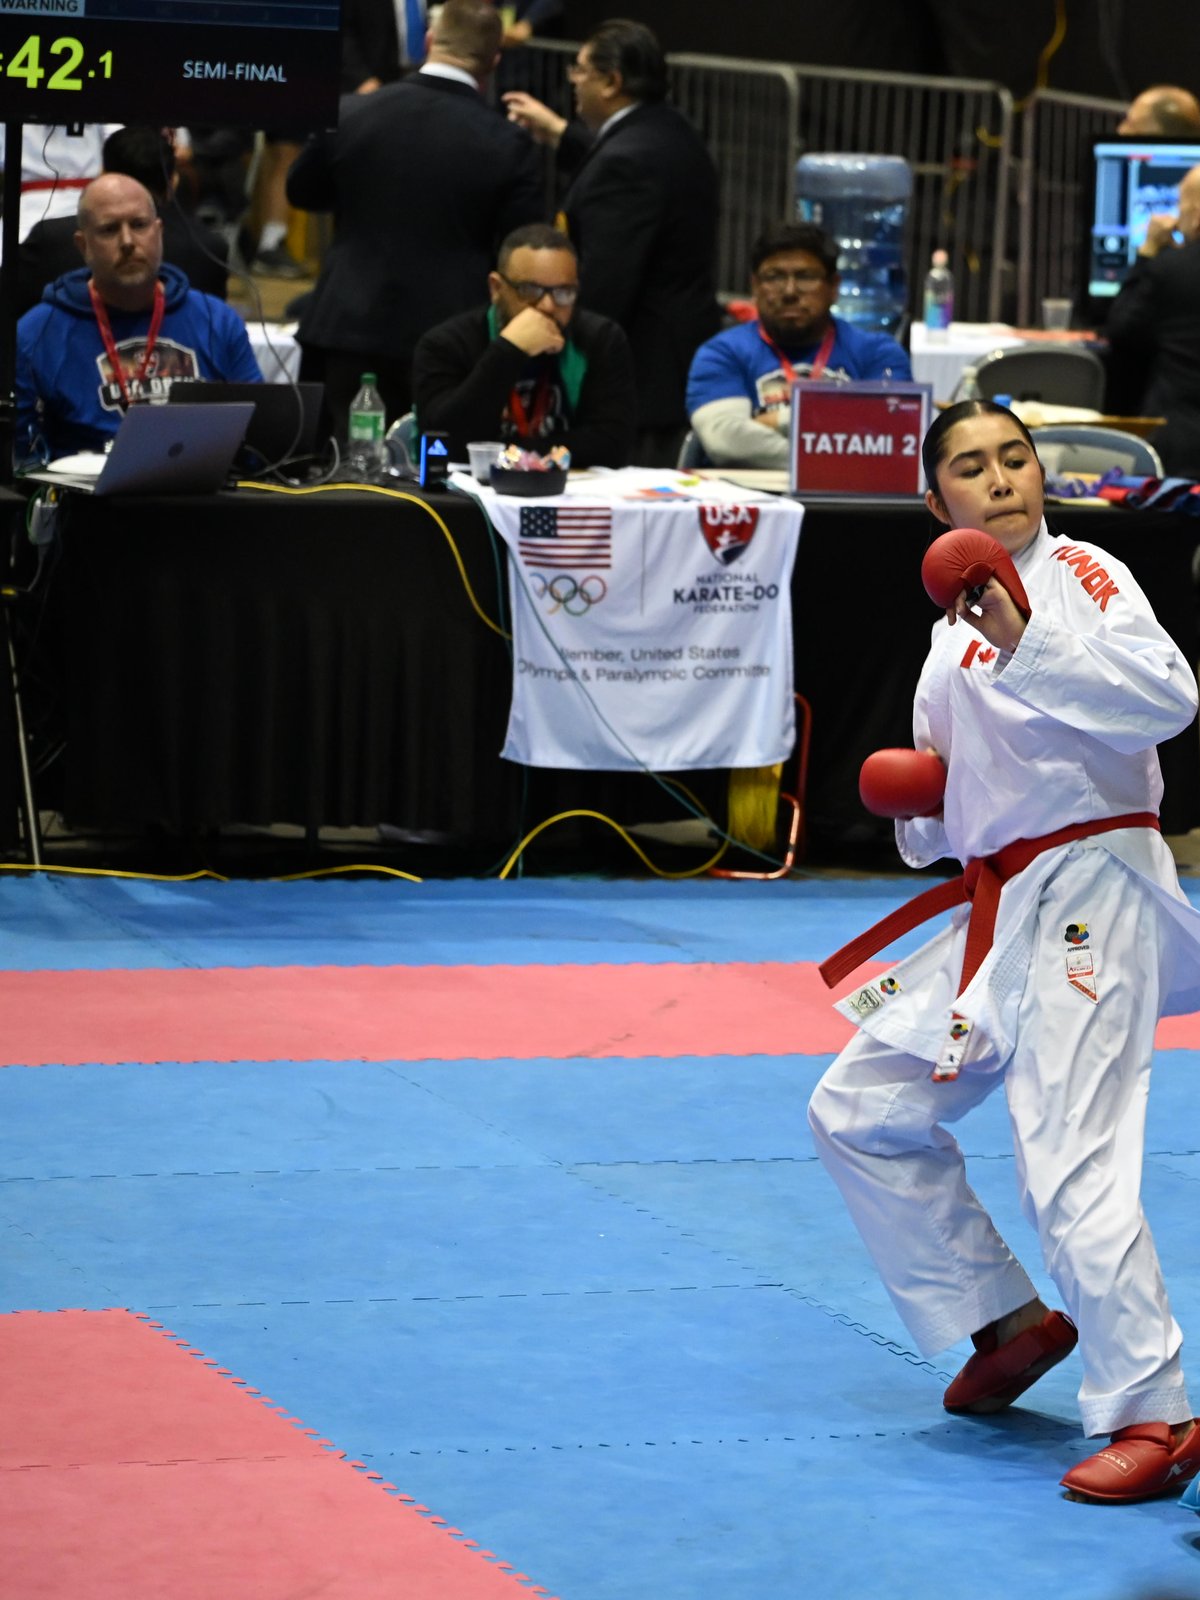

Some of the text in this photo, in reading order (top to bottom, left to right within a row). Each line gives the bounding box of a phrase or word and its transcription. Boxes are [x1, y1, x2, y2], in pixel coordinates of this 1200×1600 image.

[0, 0, 79, 12] WARNING
[182, 60, 288, 83] SEMI-FINAL
[801, 432, 917, 456] TATAMI 2
[705, 505, 753, 526] USA
[696, 573, 759, 585] NATIONAL
[673, 584, 780, 604] KARATE-DO
[693, 603, 760, 614] FEDERATION
[631, 647, 683, 661] United
[688, 646, 741, 660] States
[581, 668, 592, 682] &
[596, 667, 687, 684] Paralympic
[1067, 944, 1090, 953] APPROVED
